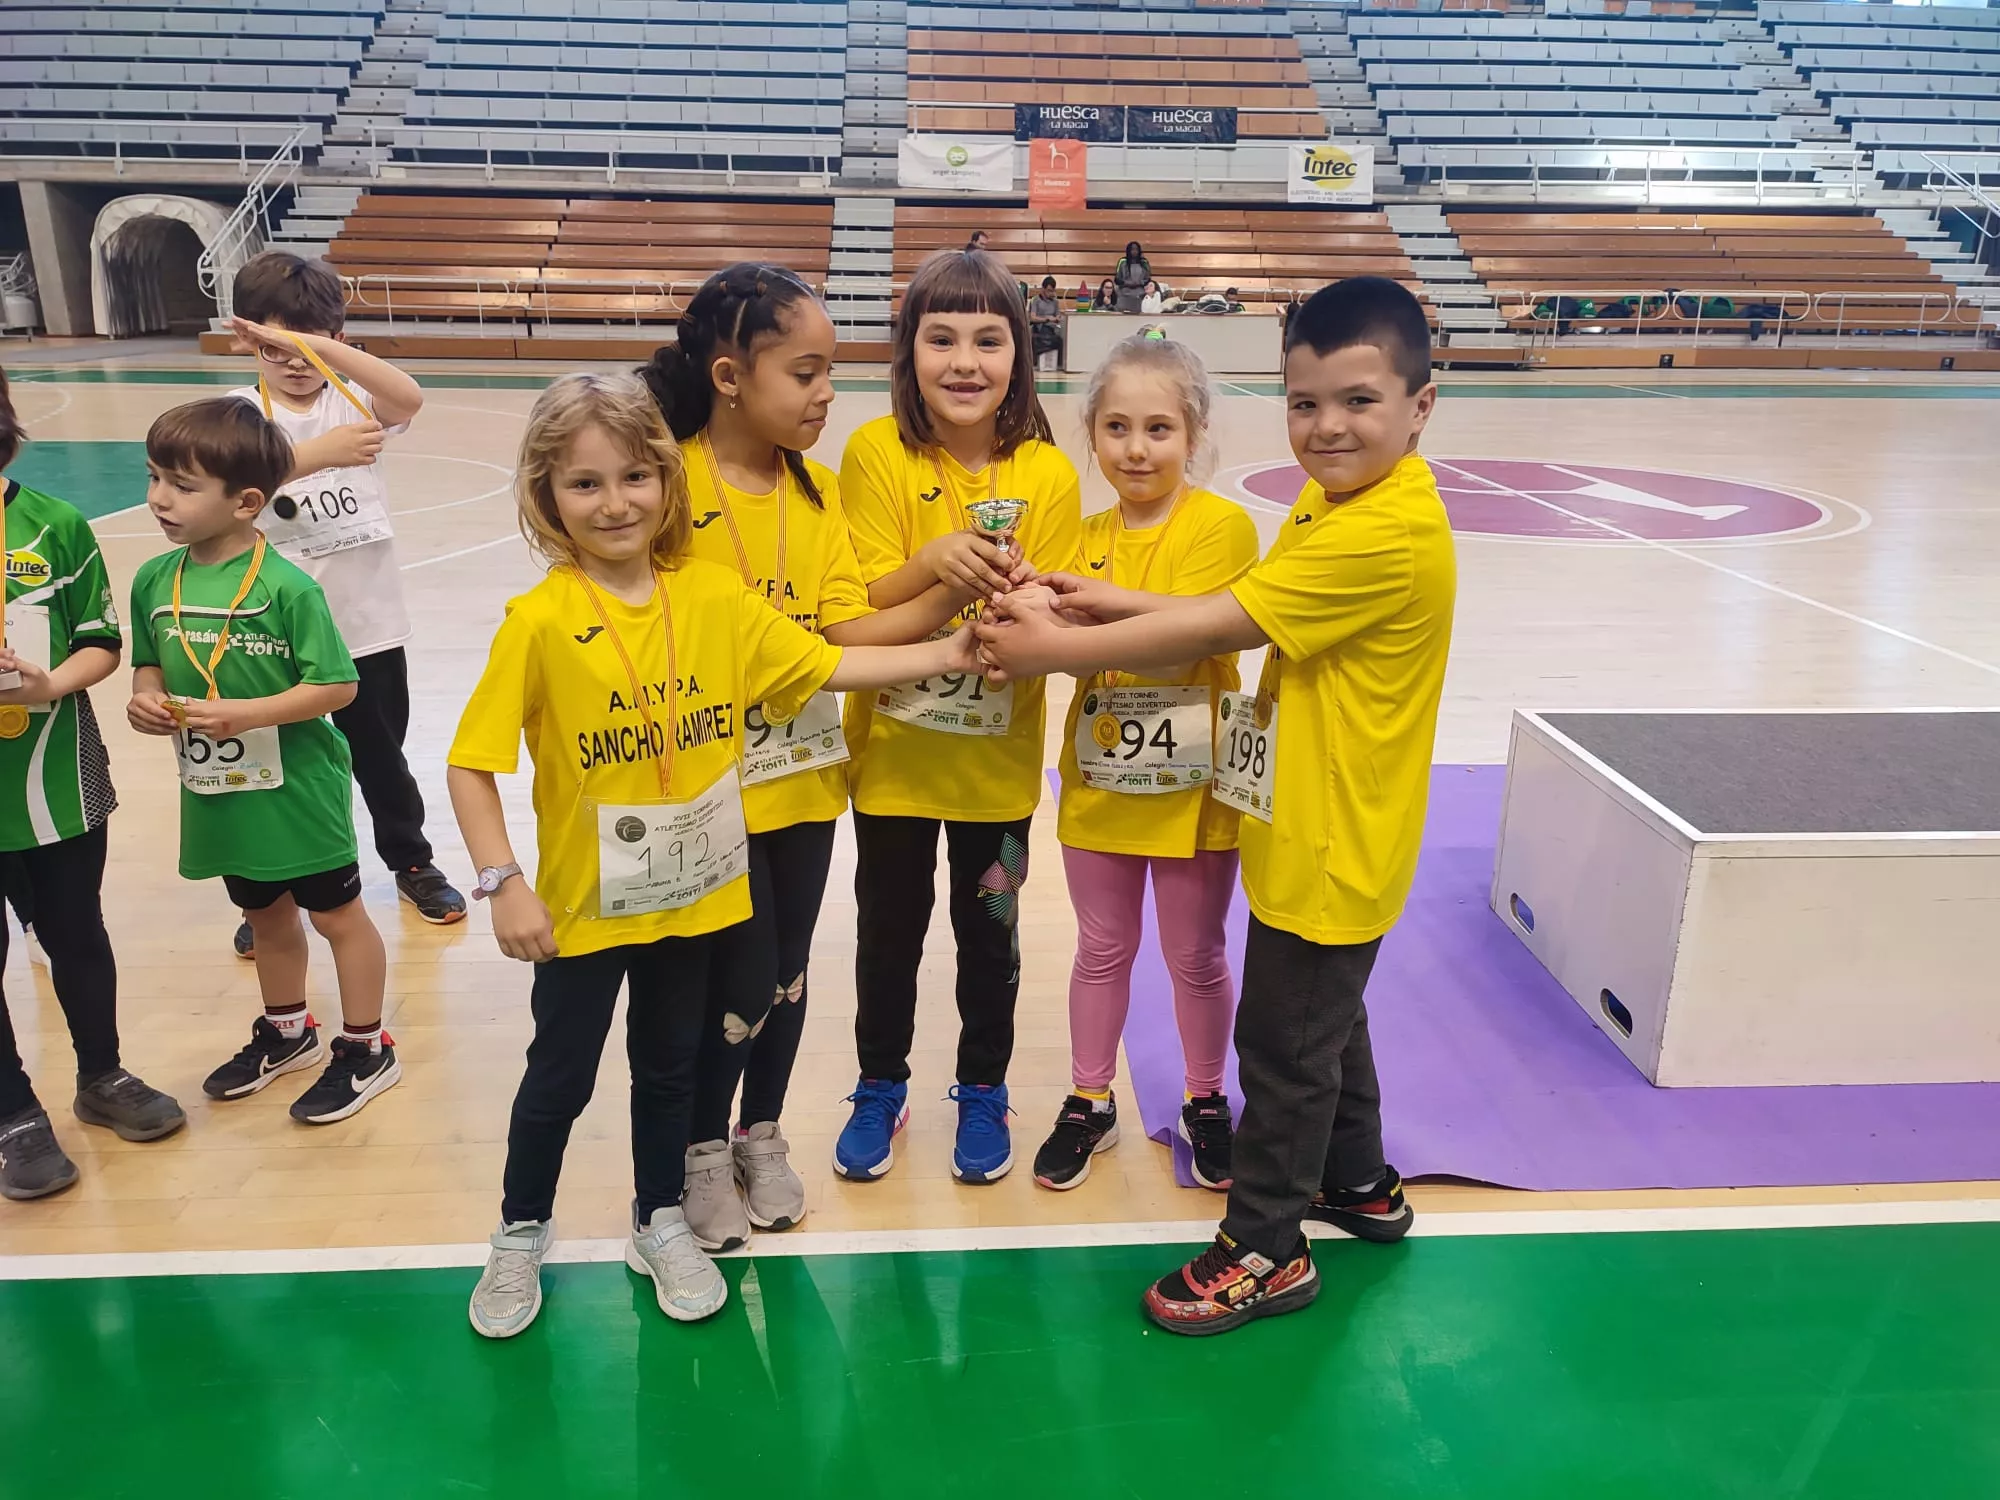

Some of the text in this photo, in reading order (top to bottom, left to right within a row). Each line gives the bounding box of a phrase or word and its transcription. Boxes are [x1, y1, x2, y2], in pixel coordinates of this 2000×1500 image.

[300, 486, 359, 523] 106
[1098, 701, 1178, 710] ATTISMO DIVERTIDO
[1129, 691, 1159, 699] TORNEO
[577, 720, 664, 770] SANCHO
[1102, 718, 1178, 761] 94
[1228, 727, 1267, 779] 198
[654, 819, 698, 832] ATLETISMO
[638, 831, 716, 880] 192
